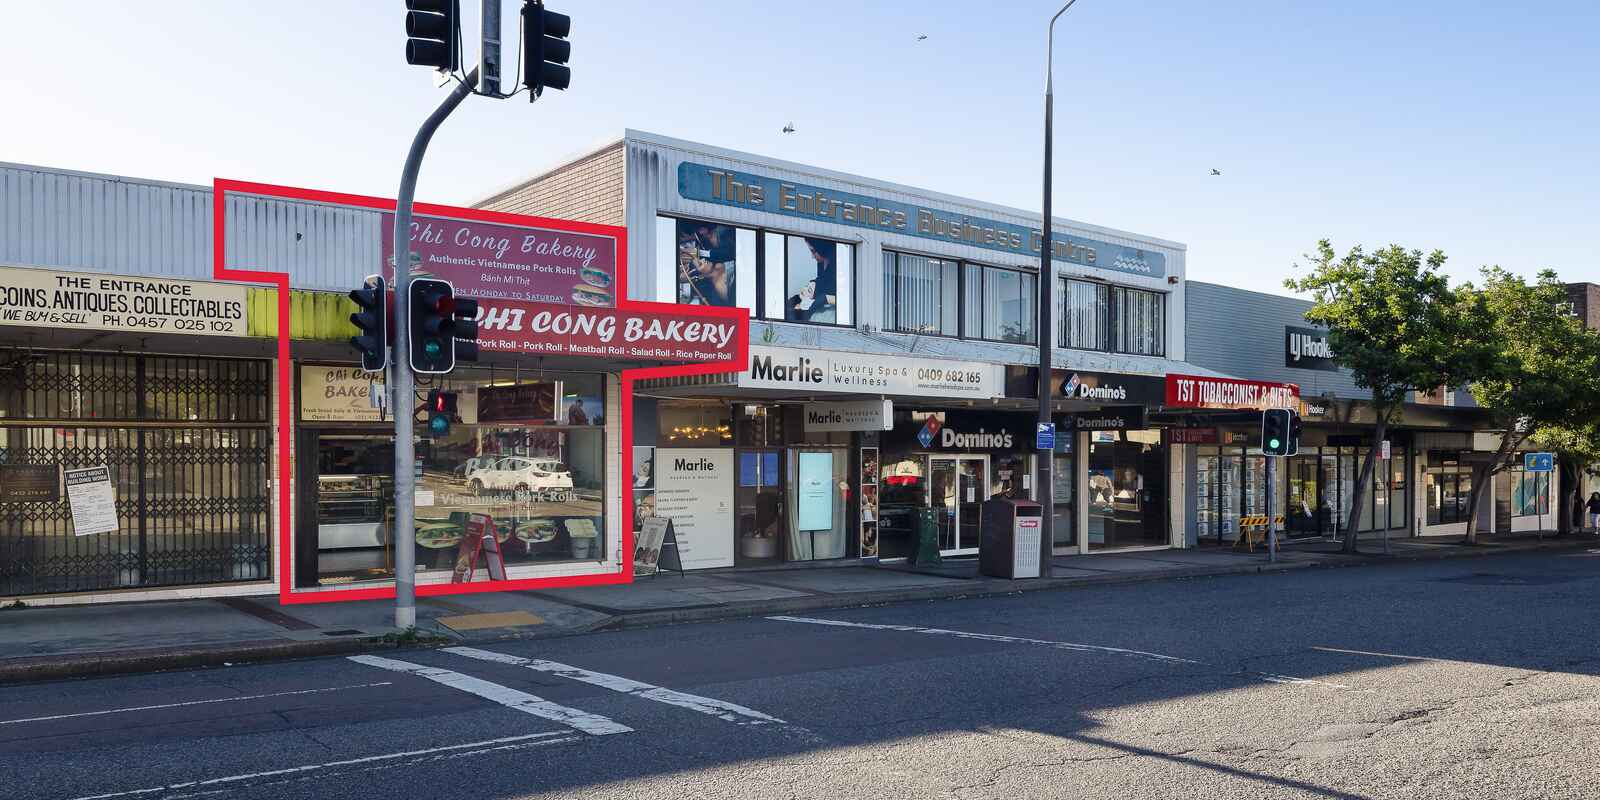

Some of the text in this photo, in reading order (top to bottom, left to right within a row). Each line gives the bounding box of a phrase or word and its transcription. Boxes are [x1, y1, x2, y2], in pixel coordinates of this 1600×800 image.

[708, 169, 1097, 263] The Entrance Business Cntre
[455, 227, 510, 259] Cong
[521, 235, 596, 267] Bakery
[429, 254, 576, 275] Authentic Vietnamese Pork Rolls
[56, 276, 191, 296] THE ENTRANCE
[134, 295, 241, 319] COLLECTABLES
[25, 310, 49, 322] BUY
[103, 315, 233, 332] PH. 0457 025 102
[531, 311, 616, 342] CONG
[500, 340, 516, 349] Roll
[523, 341, 544, 350] Pork
[546, 342, 562, 352] Roll
[569, 344, 606, 354] Meatball
[609, 346, 624, 355] Roll
[631, 347, 654, 357] Salad
[655, 348, 670, 357] Roll
[676, 349, 693, 358] Rice
[695, 351, 716, 360] Paper
[717, 352, 731, 360] Roll
[752, 355, 823, 383] Marlie
[834, 363, 873, 376] Luxury
[878, 366, 898, 379] Spa
[918, 368, 981, 383] 0409 682 165
[834, 375, 888, 386] Wellness
[1080, 383, 1126, 399] Domino's
[1177, 379, 1195, 402] TST
[1198, 380, 1258, 406] TOBACCONIST
[1270, 388, 1293, 408] GIFTS
[808, 410, 841, 425] Marlie
[1077, 416, 1124, 427] Domino's
[942, 428, 1013, 448] Domino's
[675, 458, 714, 471] Marlie
[69, 471, 87, 479] NOTICE
[550, 490, 577, 502] Rolls
